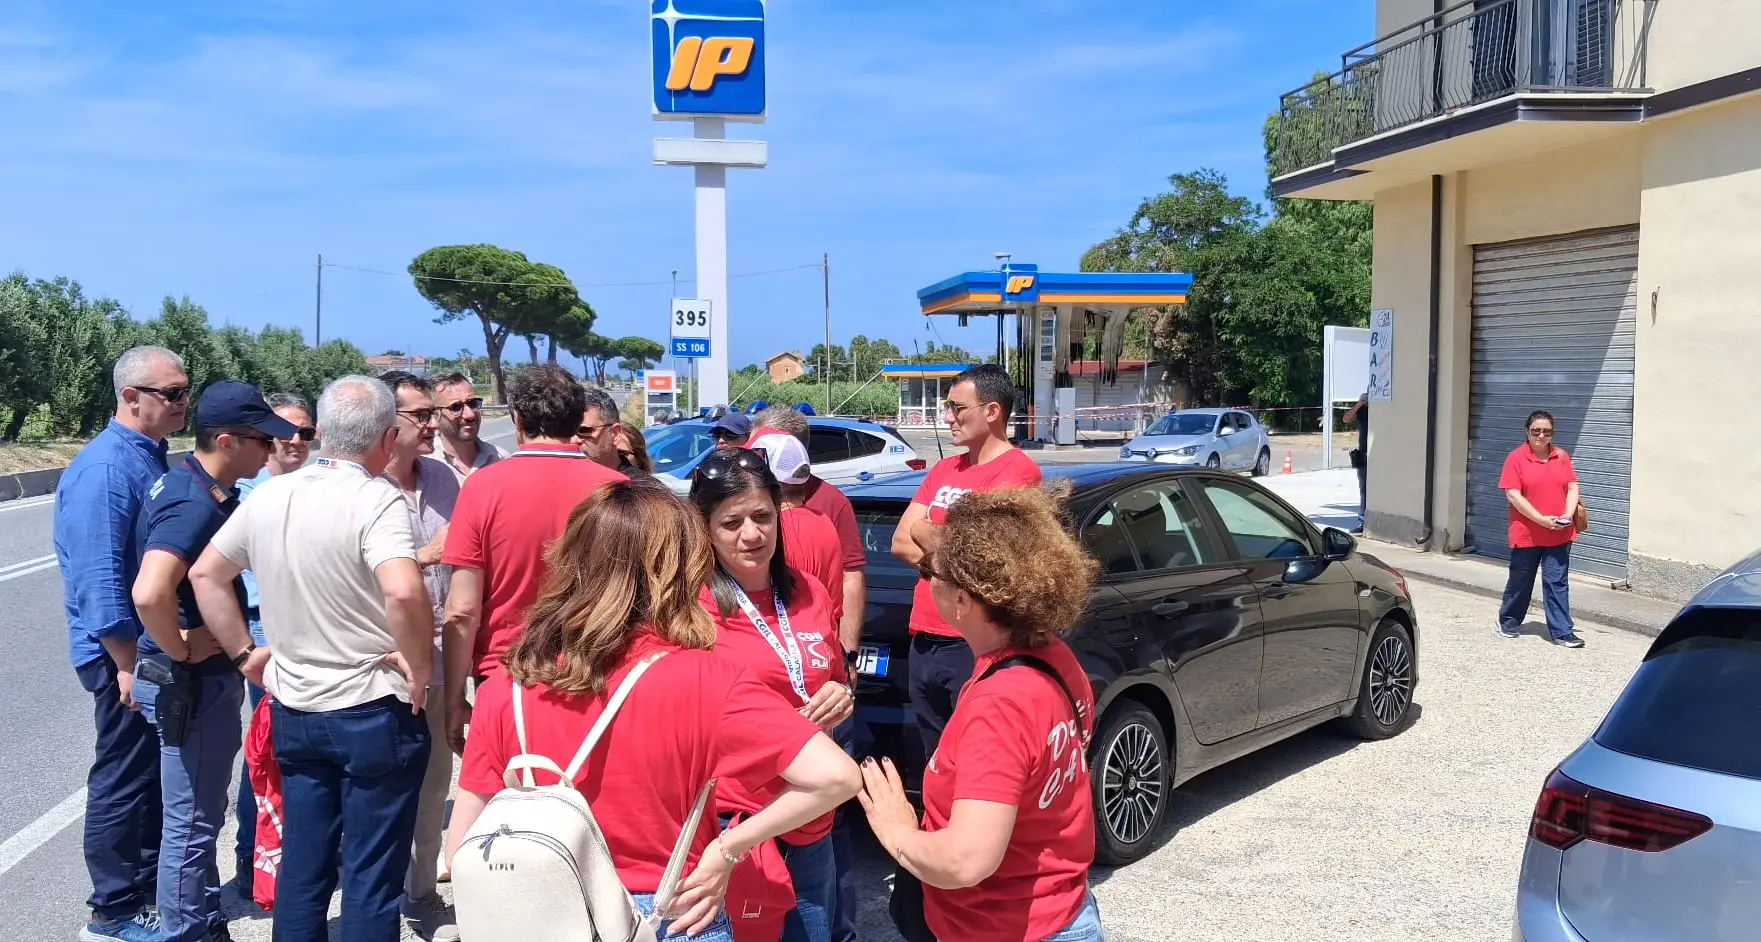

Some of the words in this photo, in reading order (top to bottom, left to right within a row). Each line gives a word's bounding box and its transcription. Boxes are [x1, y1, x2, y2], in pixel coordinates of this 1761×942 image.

[665, 36, 755, 91] IP
[1006, 275, 1034, 294] IP
[675, 310, 707, 326] 395
[676, 342, 687, 352] SS
[690, 343, 706, 353] 106
[755, 618, 772, 638] CGIL
